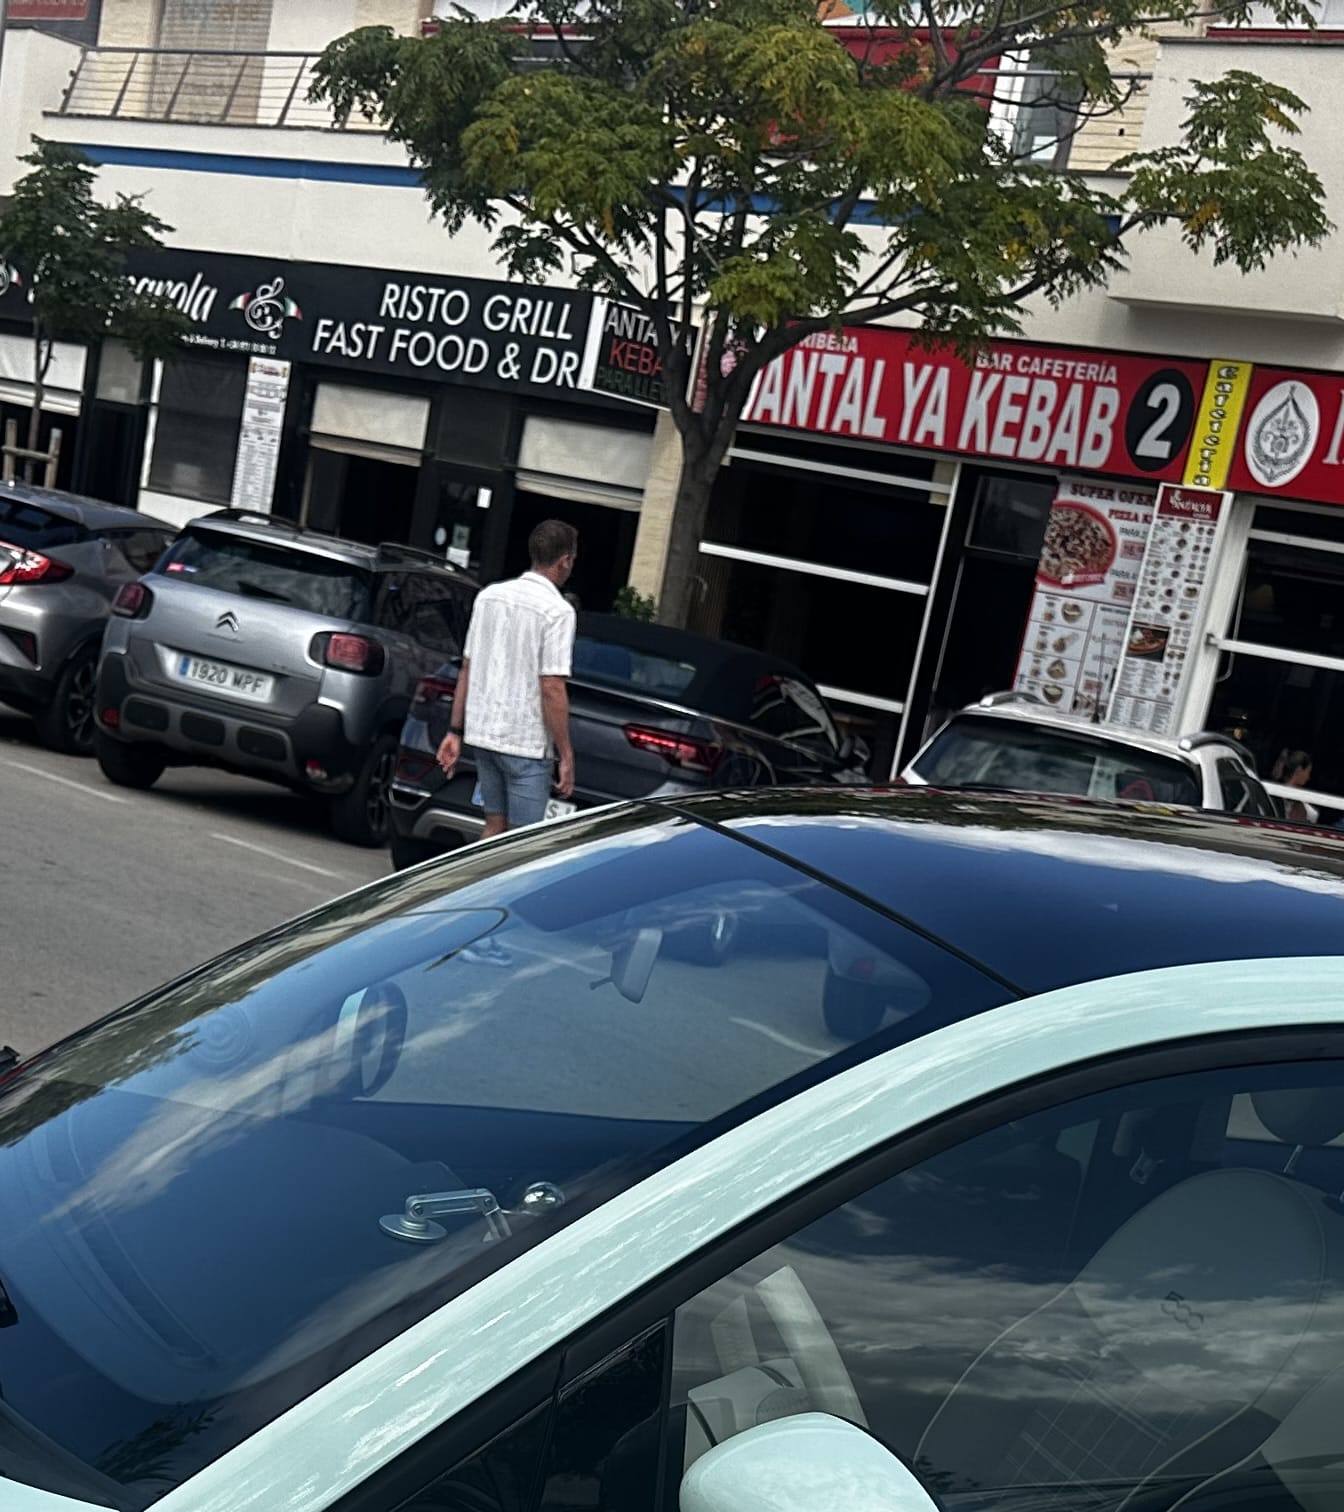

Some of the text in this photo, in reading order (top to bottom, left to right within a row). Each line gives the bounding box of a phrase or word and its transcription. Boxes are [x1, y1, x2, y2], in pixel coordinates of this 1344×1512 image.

[380, 283, 573, 340] RISTO GRILL
[313, 319, 385, 360] FAST
[389, 328, 489, 373] FOOD
[497, 343, 521, 380] &
[976, 350, 1118, 384] BAR CAFETERÍA
[752, 349, 887, 438] ANTAL
[899, 362, 950, 446] YA
[958, 371, 1120, 469] KEBAB
[1135, 383, 1181, 459] 2
[192, 661, 265, 693] 1920 MPF
